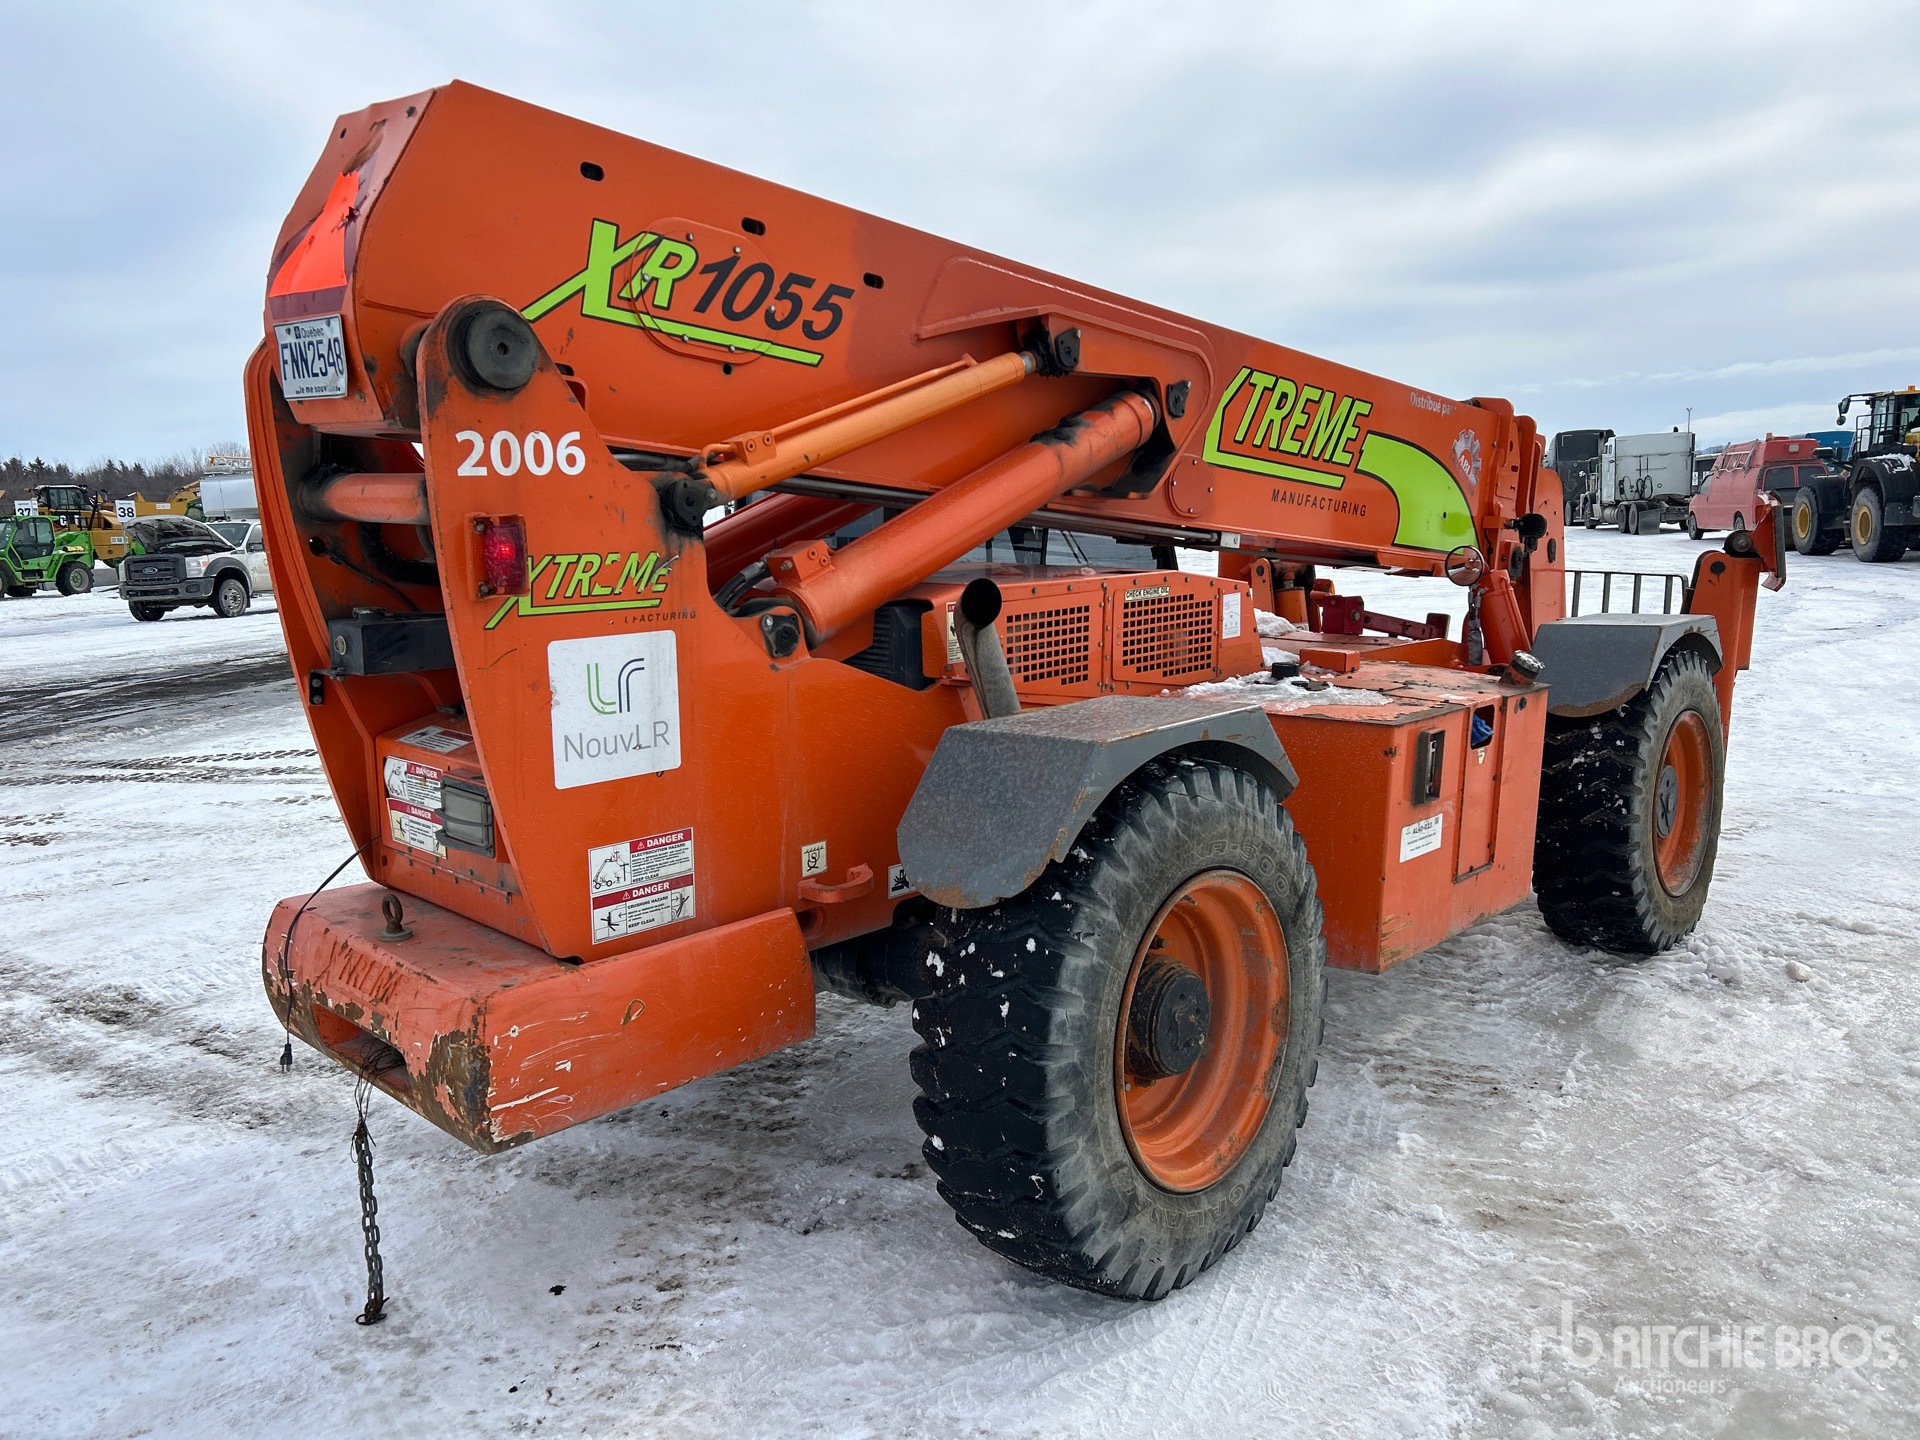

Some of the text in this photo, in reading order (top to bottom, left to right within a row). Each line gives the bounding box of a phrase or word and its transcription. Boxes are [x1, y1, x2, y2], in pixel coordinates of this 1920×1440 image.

[300, 325, 325, 339] Québec
[281, 337, 345, 381] FNN2548
[455, 430, 586, 477] 2006
[1271, 488, 1367, 517] MANUFACTURING
[117, 506, 135, 518] 38
[1143, 586, 1160, 596] ENGINE
[563, 720, 671, 762] NouvLR
[415, 766, 438, 779] DANGER
[411, 805, 432, 820] DANGER
[646, 832, 684, 848] DANGER
[632, 881, 670, 898] DANGER
